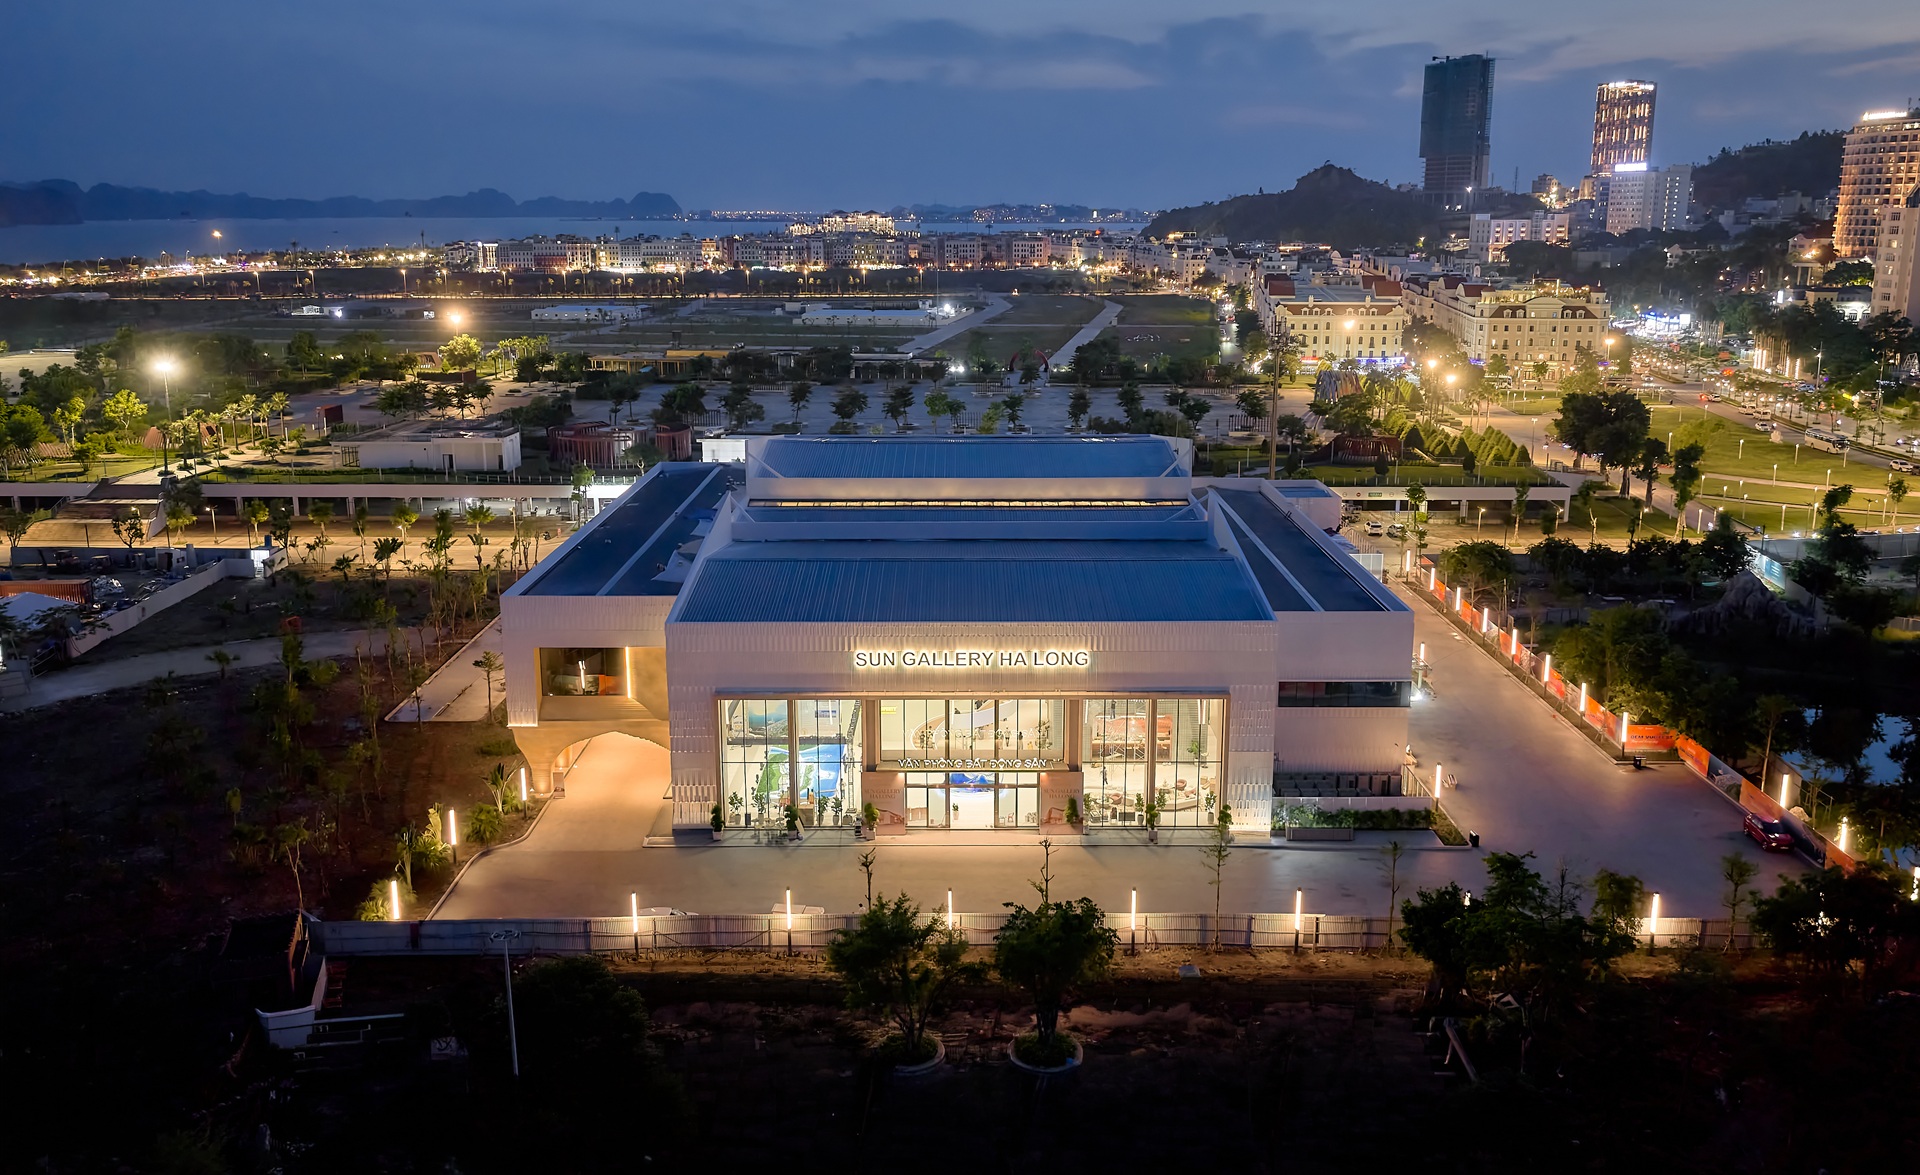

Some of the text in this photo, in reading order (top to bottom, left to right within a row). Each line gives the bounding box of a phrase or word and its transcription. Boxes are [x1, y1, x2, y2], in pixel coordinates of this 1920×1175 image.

[855, 651, 1089, 667] SUN GALLERY HA LONG
[923, 757, 963, 768] PHÒNG
